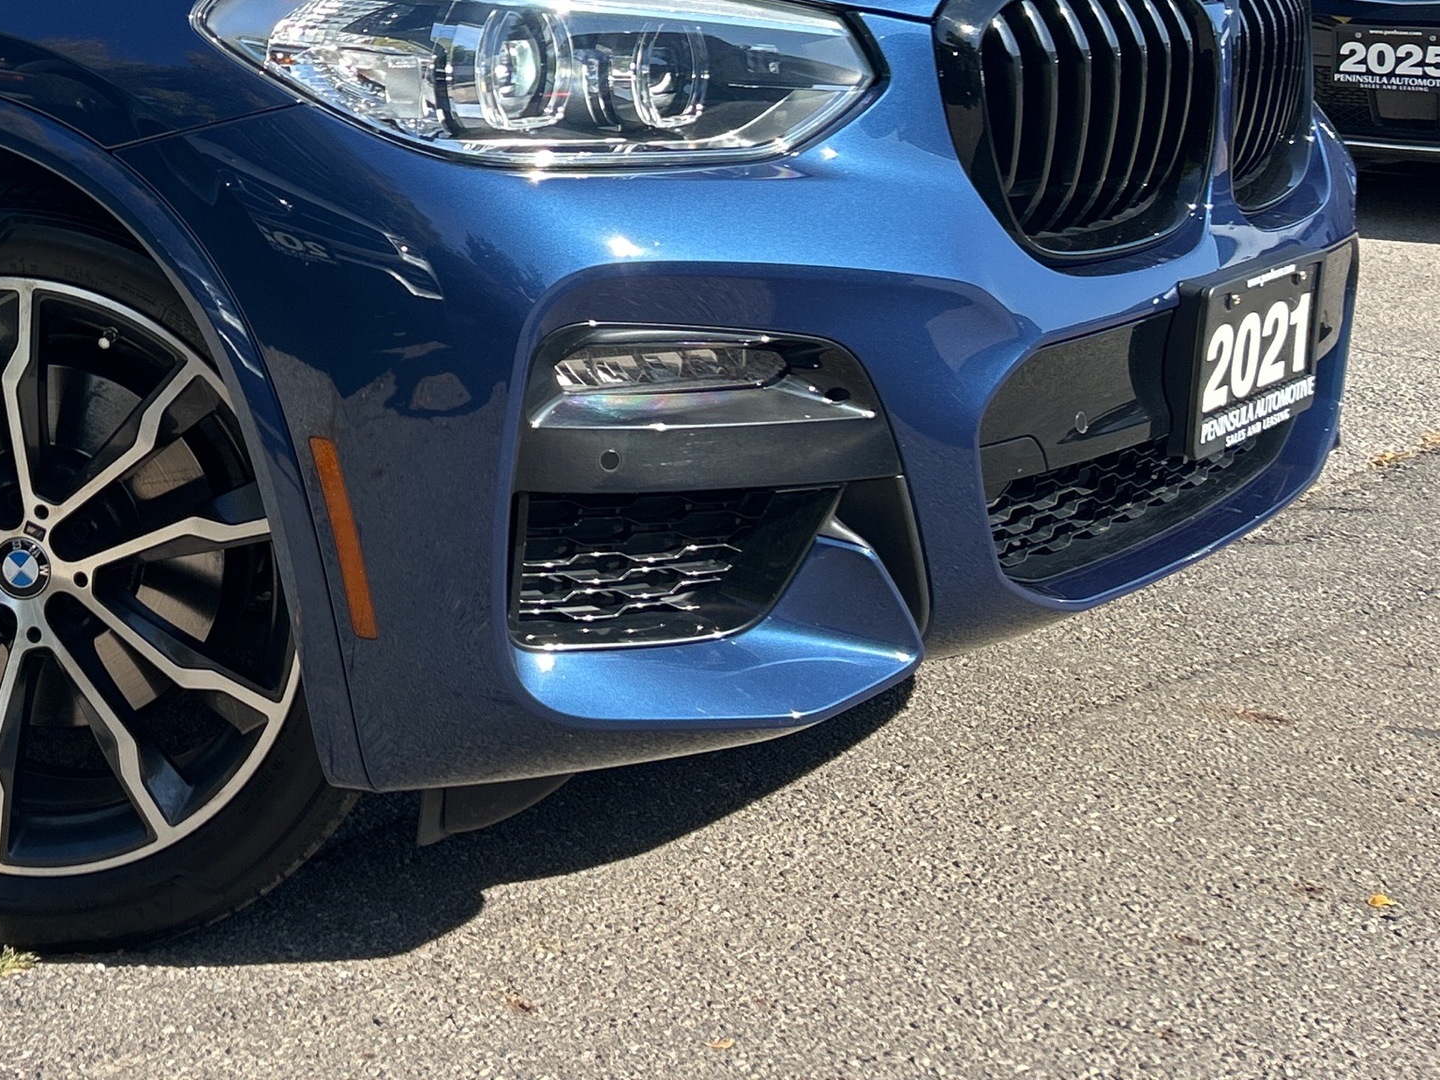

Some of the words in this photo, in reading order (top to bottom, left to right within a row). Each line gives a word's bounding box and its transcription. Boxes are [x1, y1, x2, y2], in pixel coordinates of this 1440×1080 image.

[1334, 73, 1388, 84] PENINSULA
[1339, 41, 1440, 78] 2025
[1202, 292, 1312, 413] 2021
[1200, 402, 1255, 445] PENINSULA
[1255, 375, 1317, 418] AUTOMOTIVE
[1225, 428, 1246, 448] SALES
[1247, 421, 1262, 437] AND
[1262, 408, 1291, 430] LEASING
